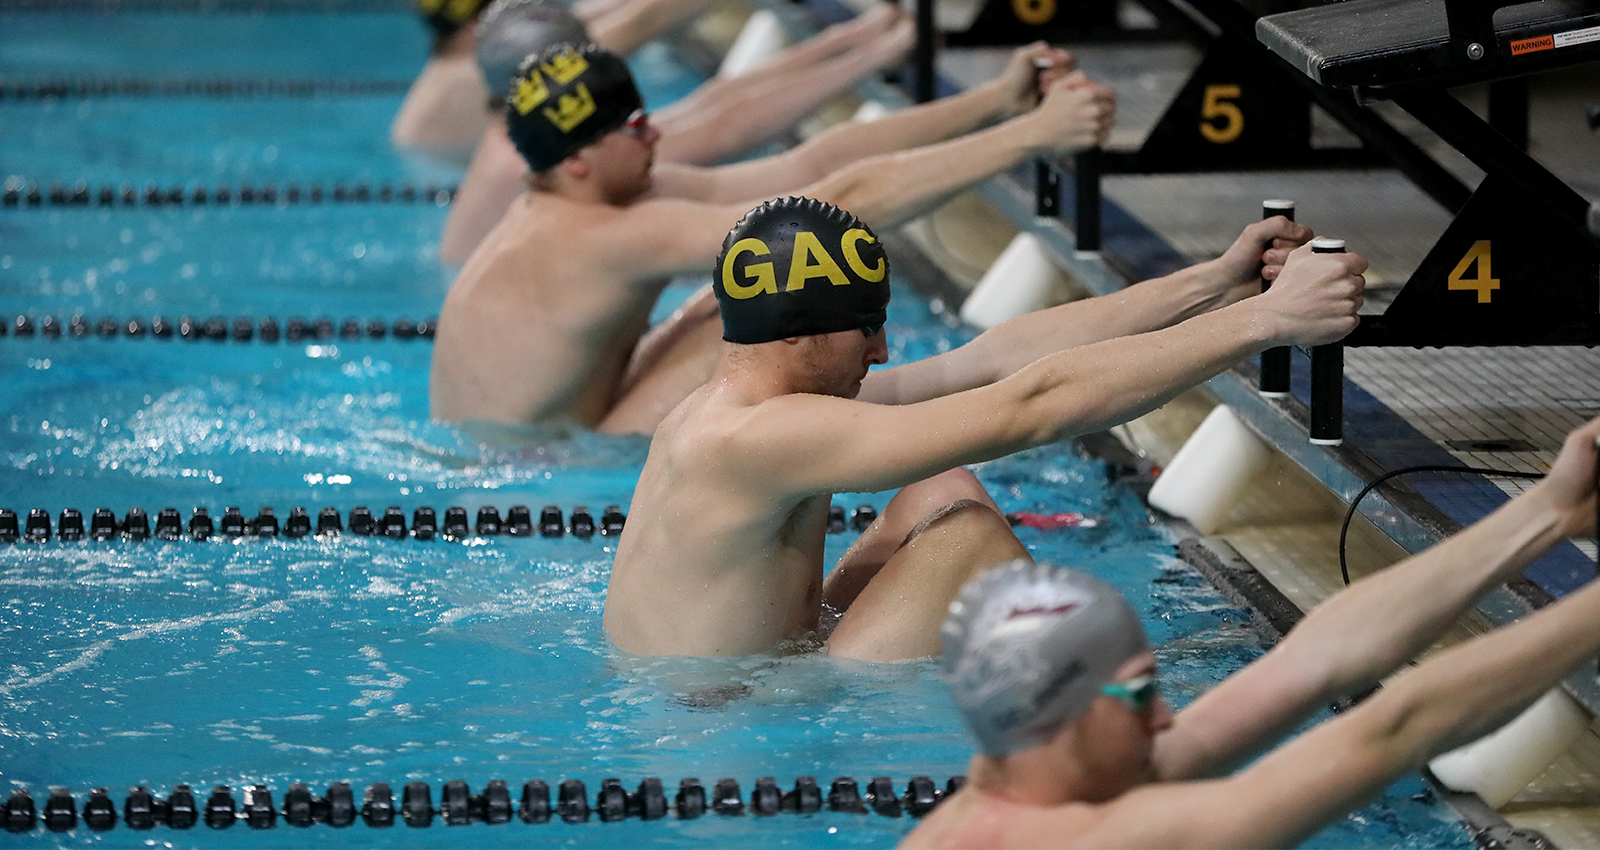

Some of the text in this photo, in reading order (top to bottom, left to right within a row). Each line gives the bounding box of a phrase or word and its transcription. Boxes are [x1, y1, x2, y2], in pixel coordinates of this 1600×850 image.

[1512, 39, 1552, 52] WARNING
[1201, 85, 1244, 143] 5
[722, 228, 886, 300] GAC
[1448, 240, 1501, 304] 4
